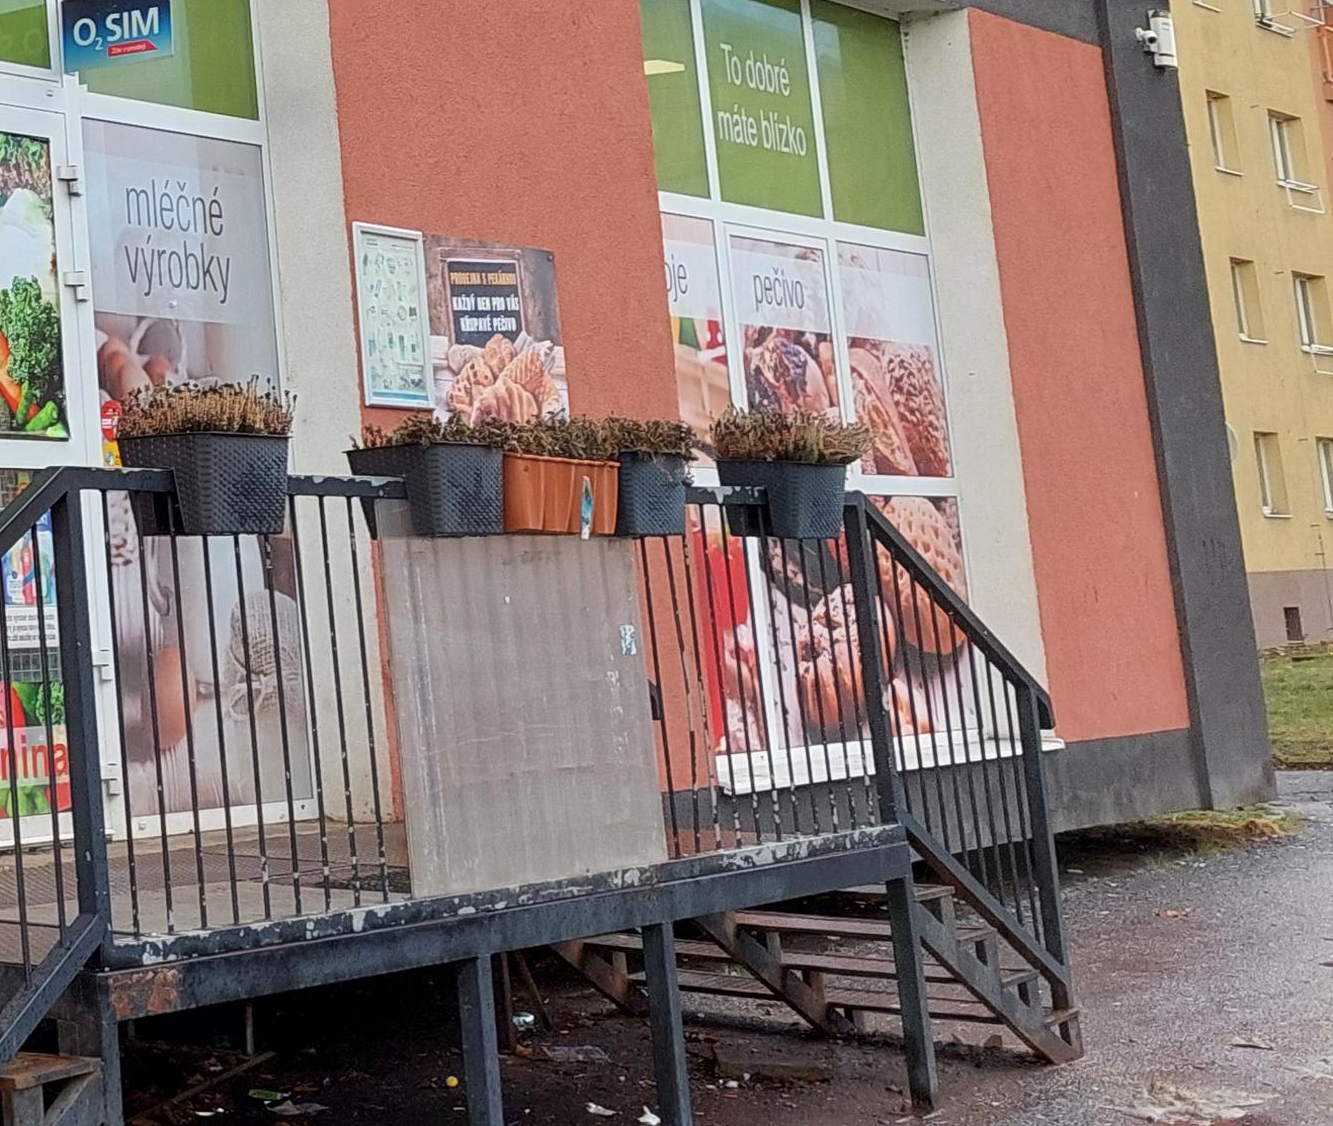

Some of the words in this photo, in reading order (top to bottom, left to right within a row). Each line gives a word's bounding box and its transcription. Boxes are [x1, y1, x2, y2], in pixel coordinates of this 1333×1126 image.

[105, 7, 159, 42] SIM
[719, 43, 742, 86] To
[746, 50, 791, 97] dobré
[717, 104, 758, 147] máte
[761, 109, 807, 157] blízko
[126, 179, 223, 236] mléčné
[124, 234, 230, 304] výrobky
[753, 267, 805, 312] pečivo
[491, 297, 505, 311] PRO
